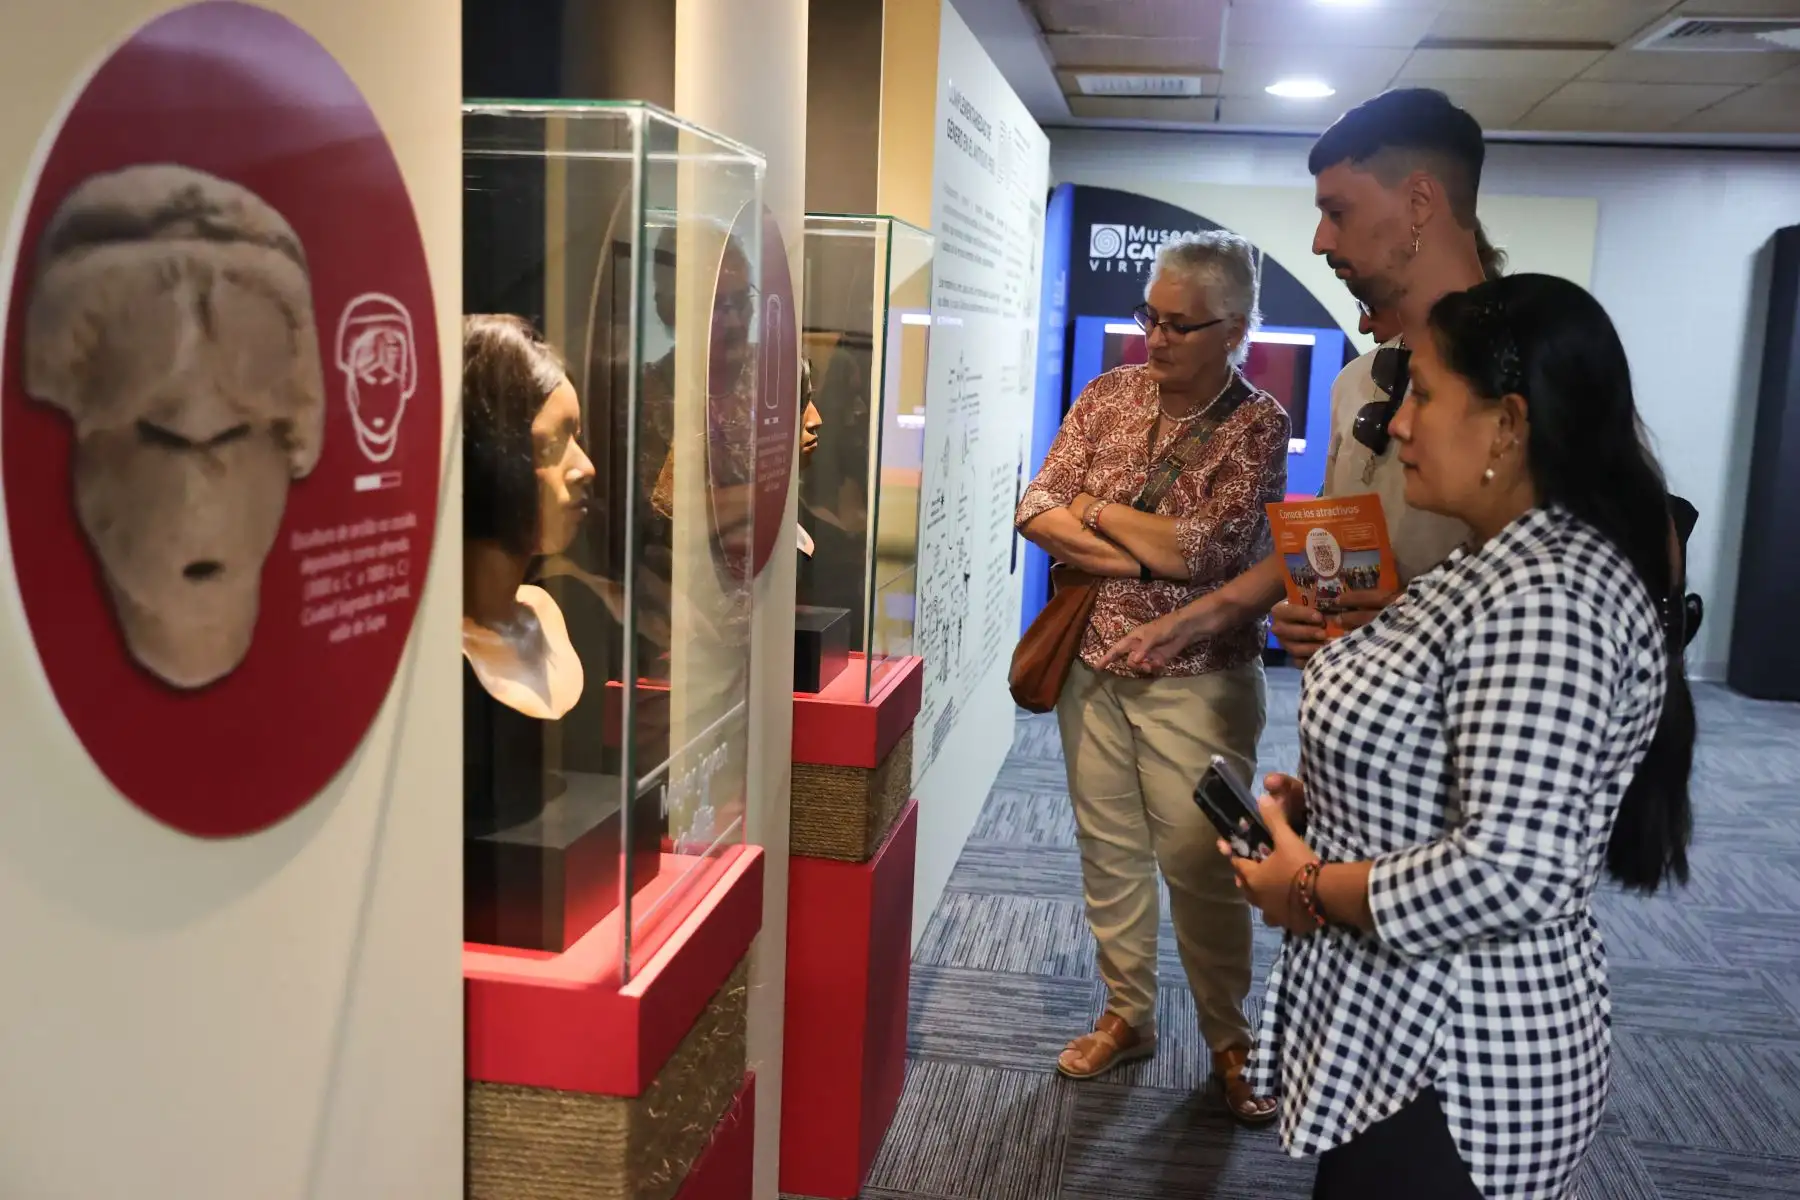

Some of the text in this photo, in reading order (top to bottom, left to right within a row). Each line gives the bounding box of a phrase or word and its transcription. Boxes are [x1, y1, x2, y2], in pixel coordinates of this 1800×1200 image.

[1089, 260, 1156, 273] VIRT
[1280, 505, 1359, 519] Conoce los atractivos
